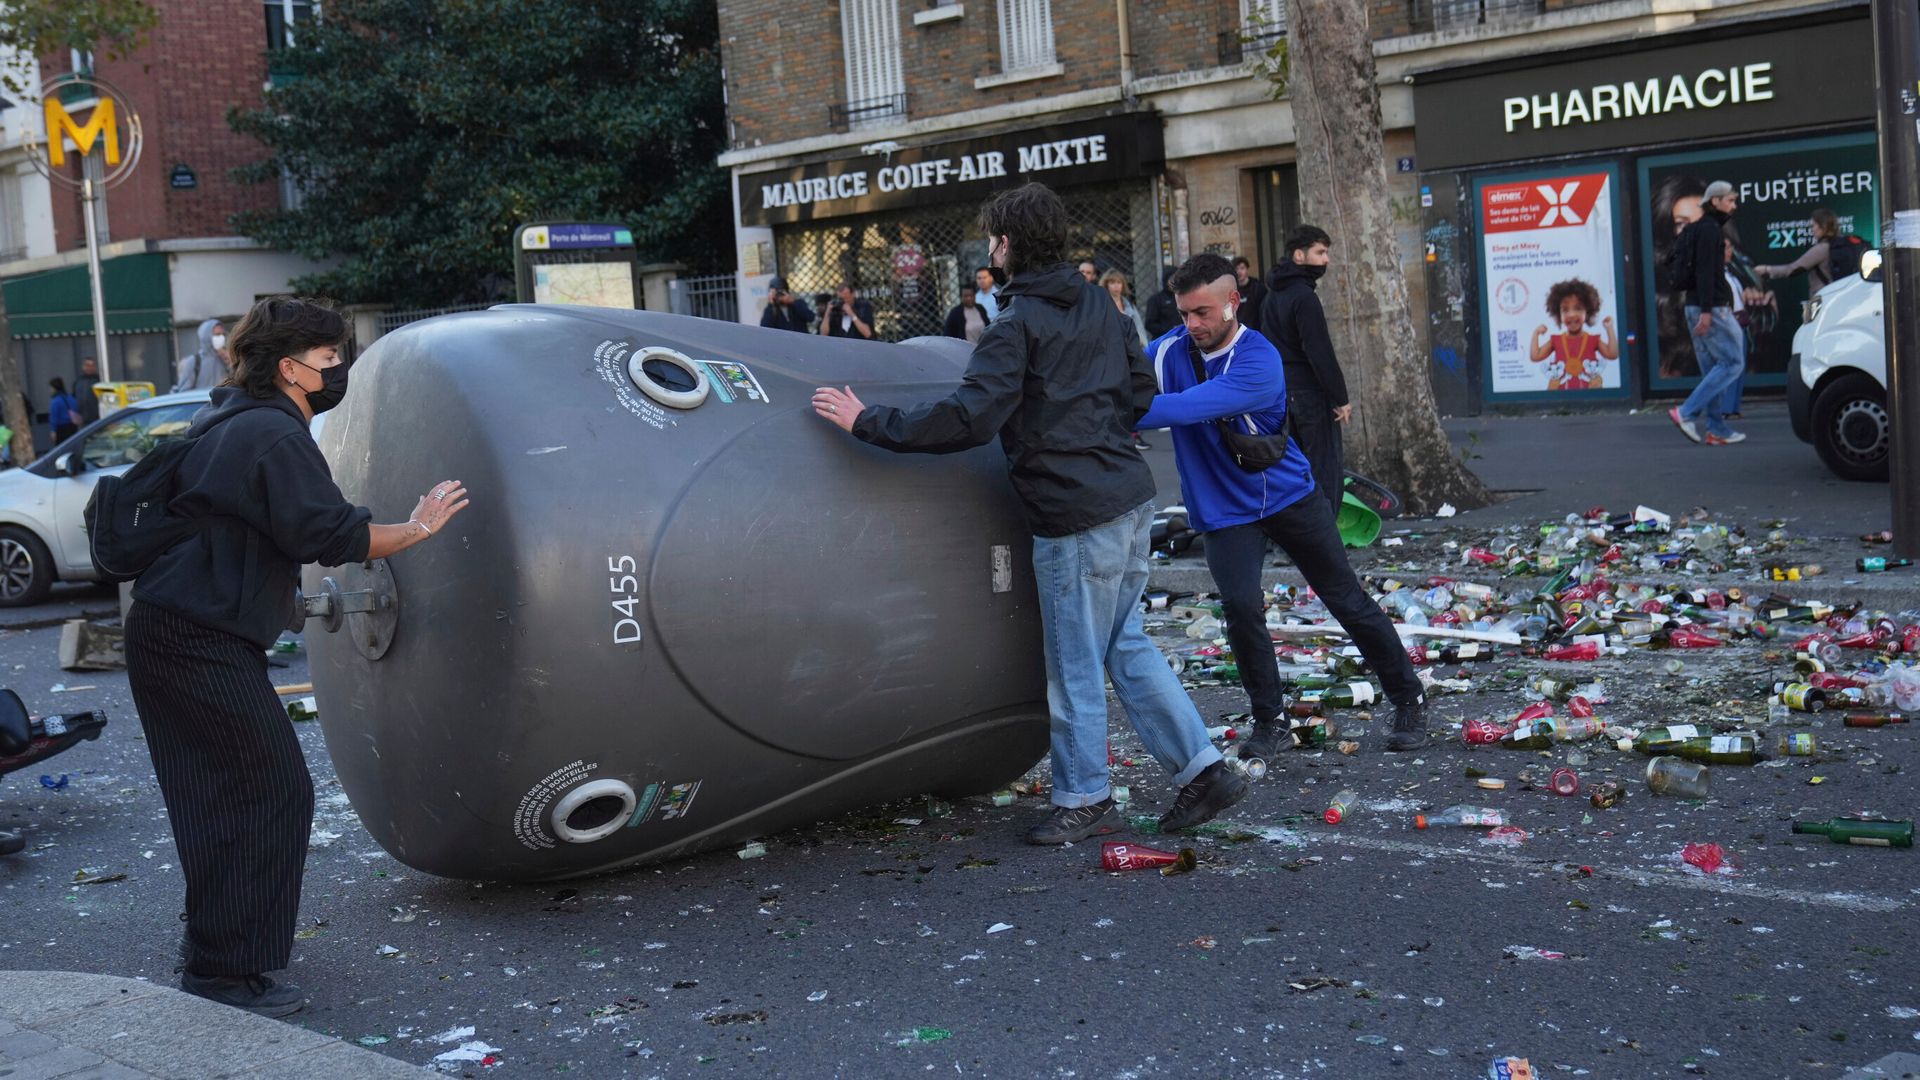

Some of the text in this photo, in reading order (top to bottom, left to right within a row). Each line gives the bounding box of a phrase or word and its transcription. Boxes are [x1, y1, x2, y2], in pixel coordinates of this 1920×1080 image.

[1504, 62, 1774, 133] PHARMACIE
[44, 96, 120, 167] M
[762, 134, 1107, 209] MAURICE COIFF-AIR MIXTE
[1402, 159, 1410, 171] 2
[1740, 171, 1872, 203] FURTERER
[1490, 191, 1522, 203] elmex
[1520, 206, 1529, 214] de
[1780, 219, 1814, 229] CHEVEU
[551, 234, 569, 242] Porte
[580, 232, 611, 242] Montreuil
[1768, 229, 1796, 249] 2X
[642, 416, 664, 430] POUR
[608, 555, 641, 644] D455
[550, 762, 598, 789] BOUTEILLES
[513, 794, 531, 836] TRANQUILLITÉ
[527, 783, 543, 797] DES
[541, 759, 584, 786] RIVERAINS
[532, 804, 546, 826] HEURES
[542, 794, 553, 804] ET
[556, 772, 589, 792] HEURES
[535, 788, 550, 801] VOS
[524, 800, 539, 818] JETER
[522, 818, 531, 829] PAS
[523, 828, 532, 836] NE
